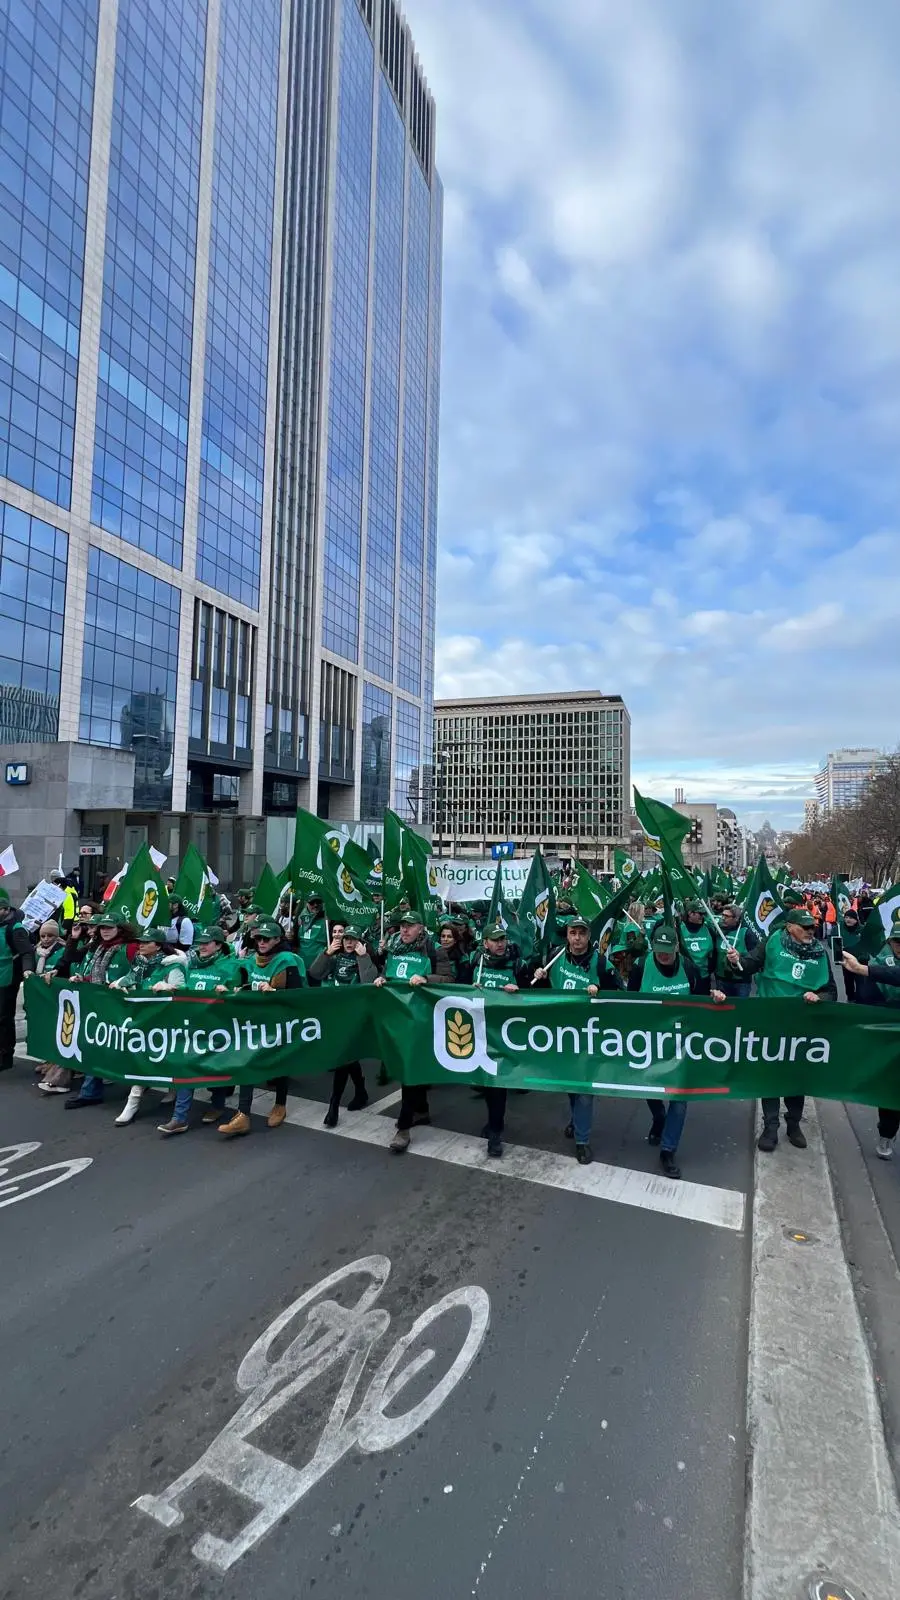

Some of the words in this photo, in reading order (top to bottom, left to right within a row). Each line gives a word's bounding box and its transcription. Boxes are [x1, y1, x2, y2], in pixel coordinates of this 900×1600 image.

[7, 765, 27, 782] M
[84, 1011, 322, 1063] Confagricoltura
[501, 1016, 831, 1068] Confagricoltura
